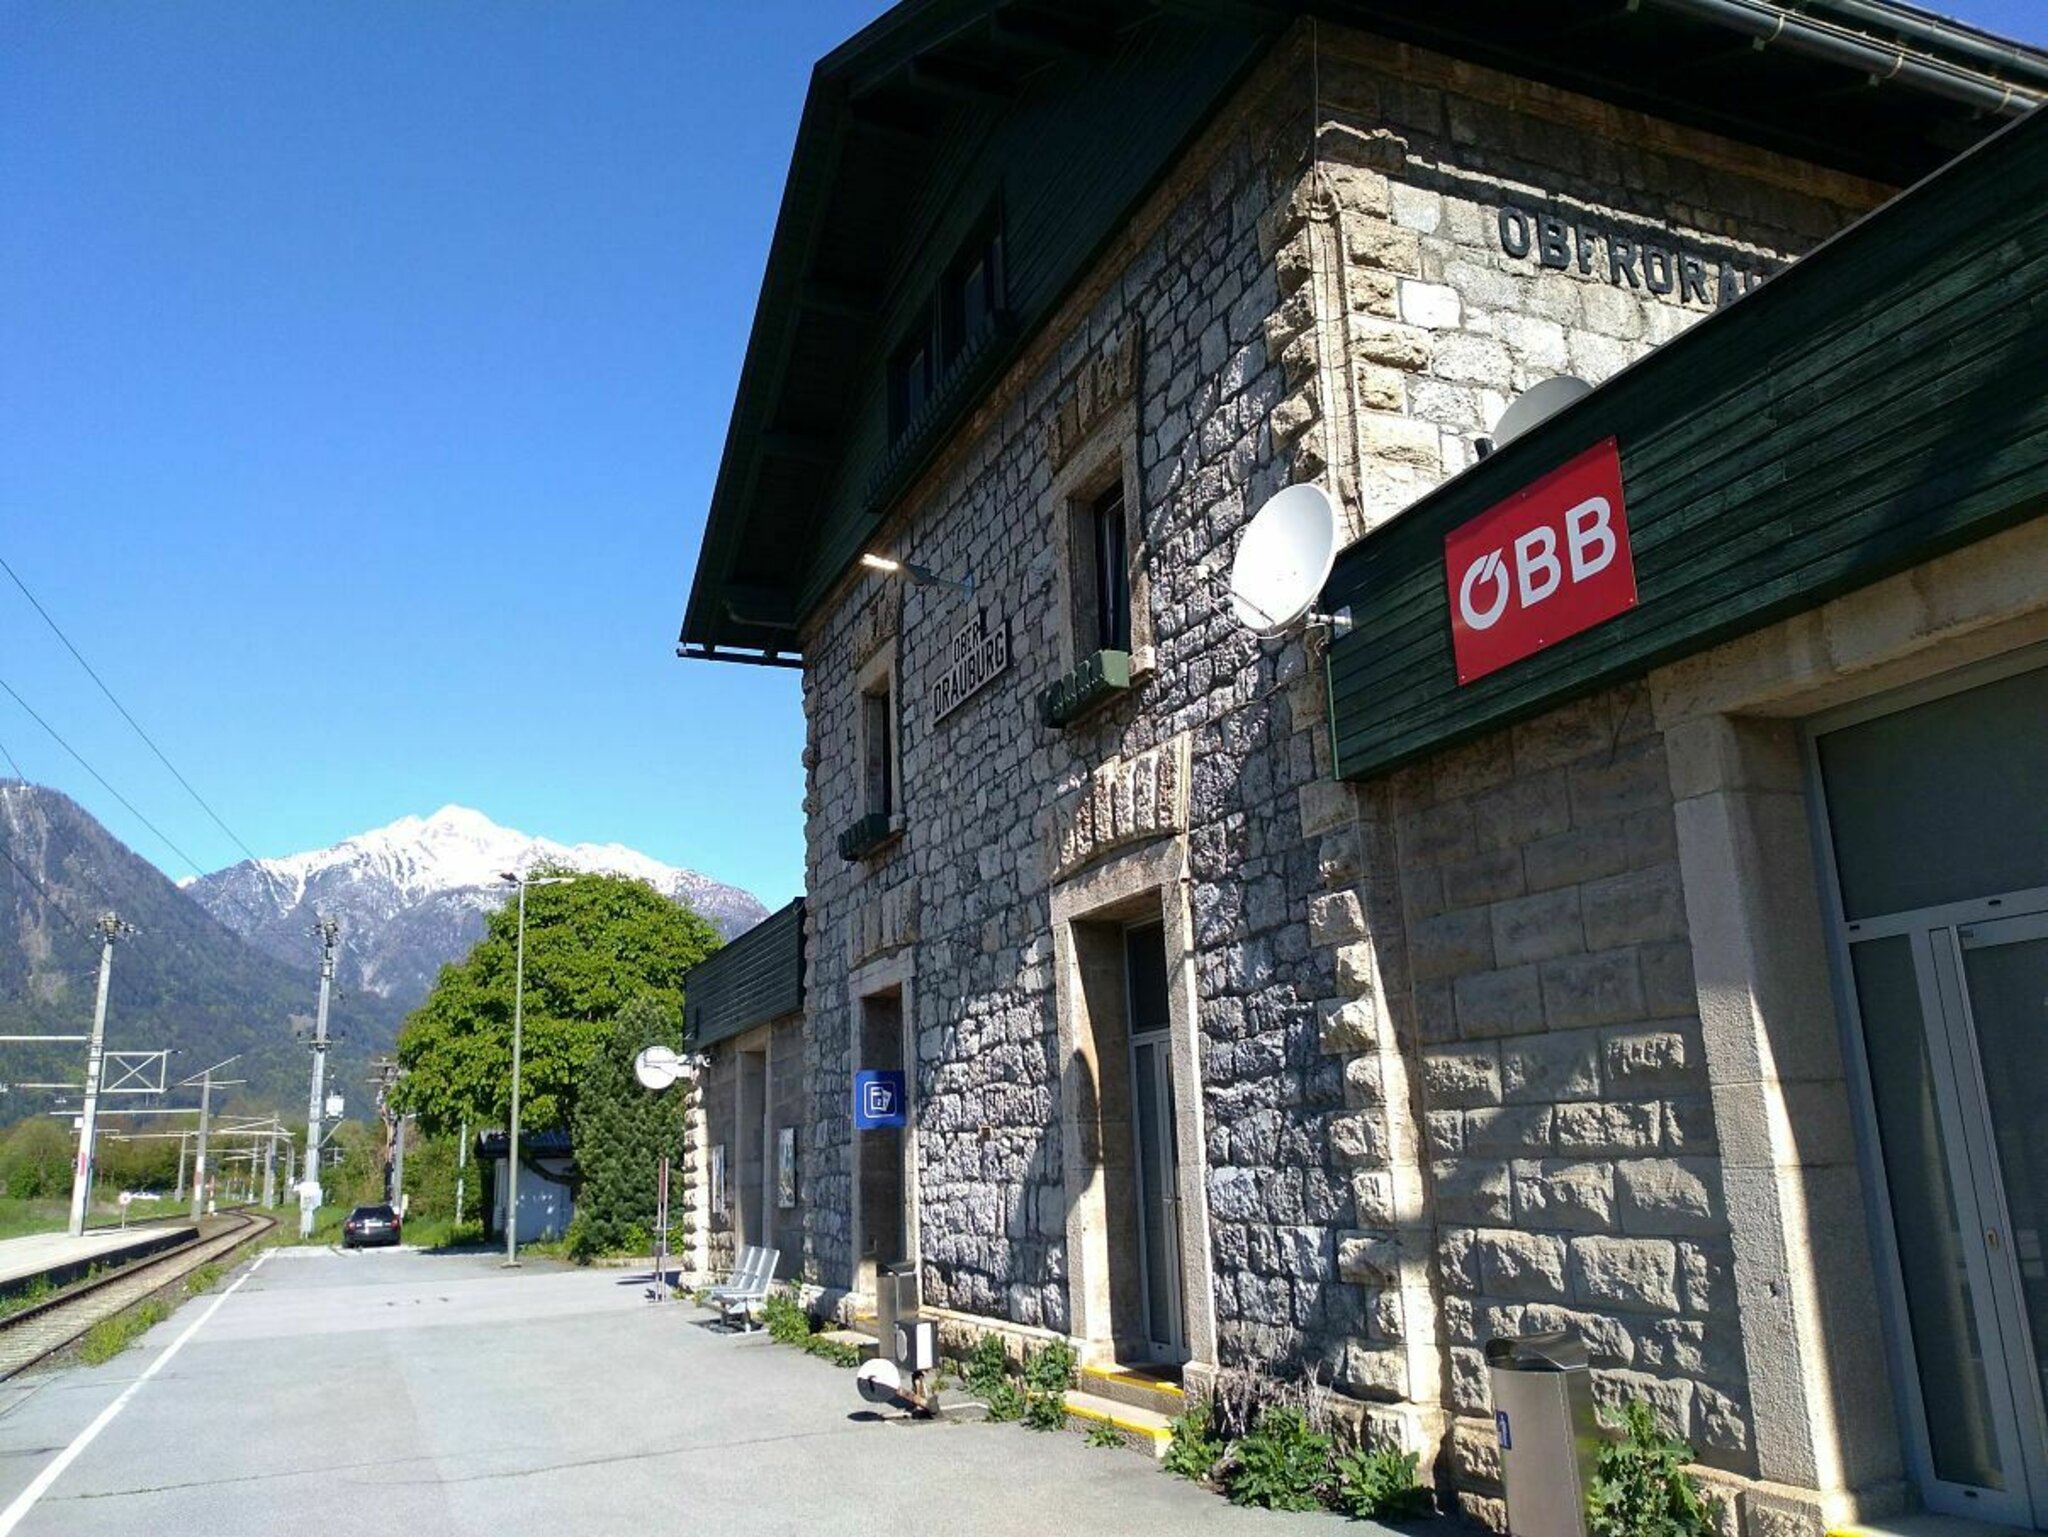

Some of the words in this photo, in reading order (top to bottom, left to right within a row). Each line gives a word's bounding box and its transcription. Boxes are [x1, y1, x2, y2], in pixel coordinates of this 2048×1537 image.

[1460, 497, 1616, 630] ÖBB
[934, 630, 1004, 716] DRAUBURG
[953, 621, 980, 663] OBER
